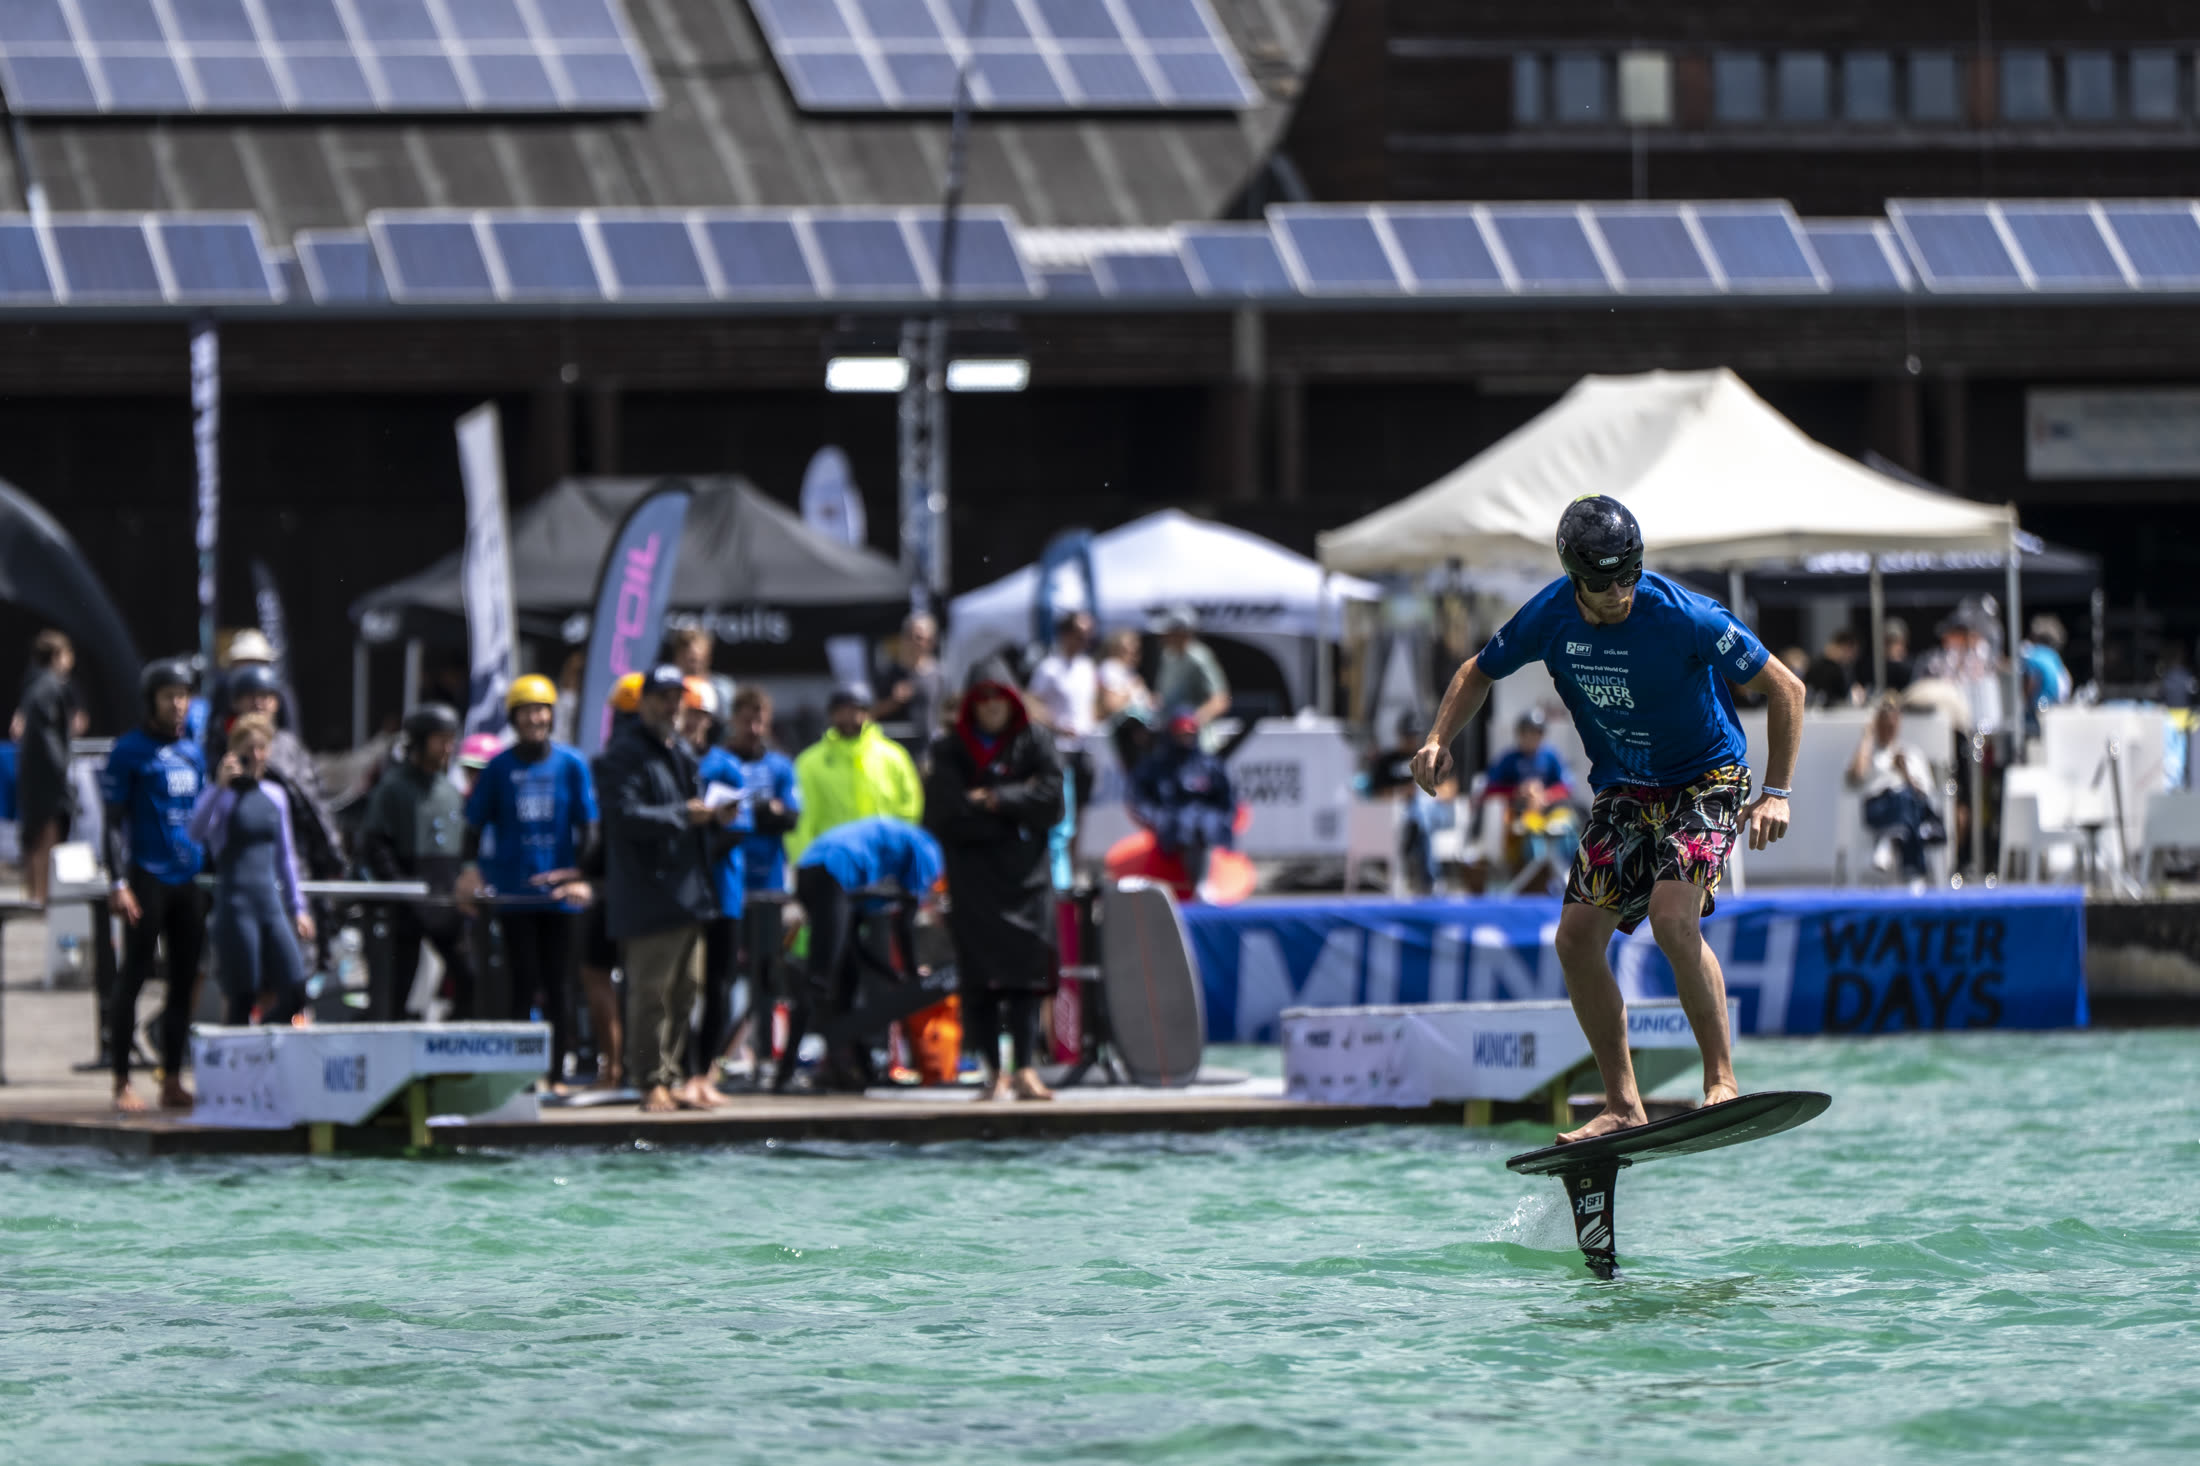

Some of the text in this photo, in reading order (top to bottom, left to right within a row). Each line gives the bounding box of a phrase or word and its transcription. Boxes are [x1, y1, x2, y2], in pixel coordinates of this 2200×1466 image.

[1576, 645, 1590, 653] SFT
[1576, 674, 1628, 687] MUNICH
[1579, 682, 1633, 699] WATER
[1824, 917, 2003, 964] WATER
[1236, 916, 1798, 1038] MUNCH
[1824, 973, 2003, 1033] DAYS
[1587, 1195, 1604, 1207] SFT
